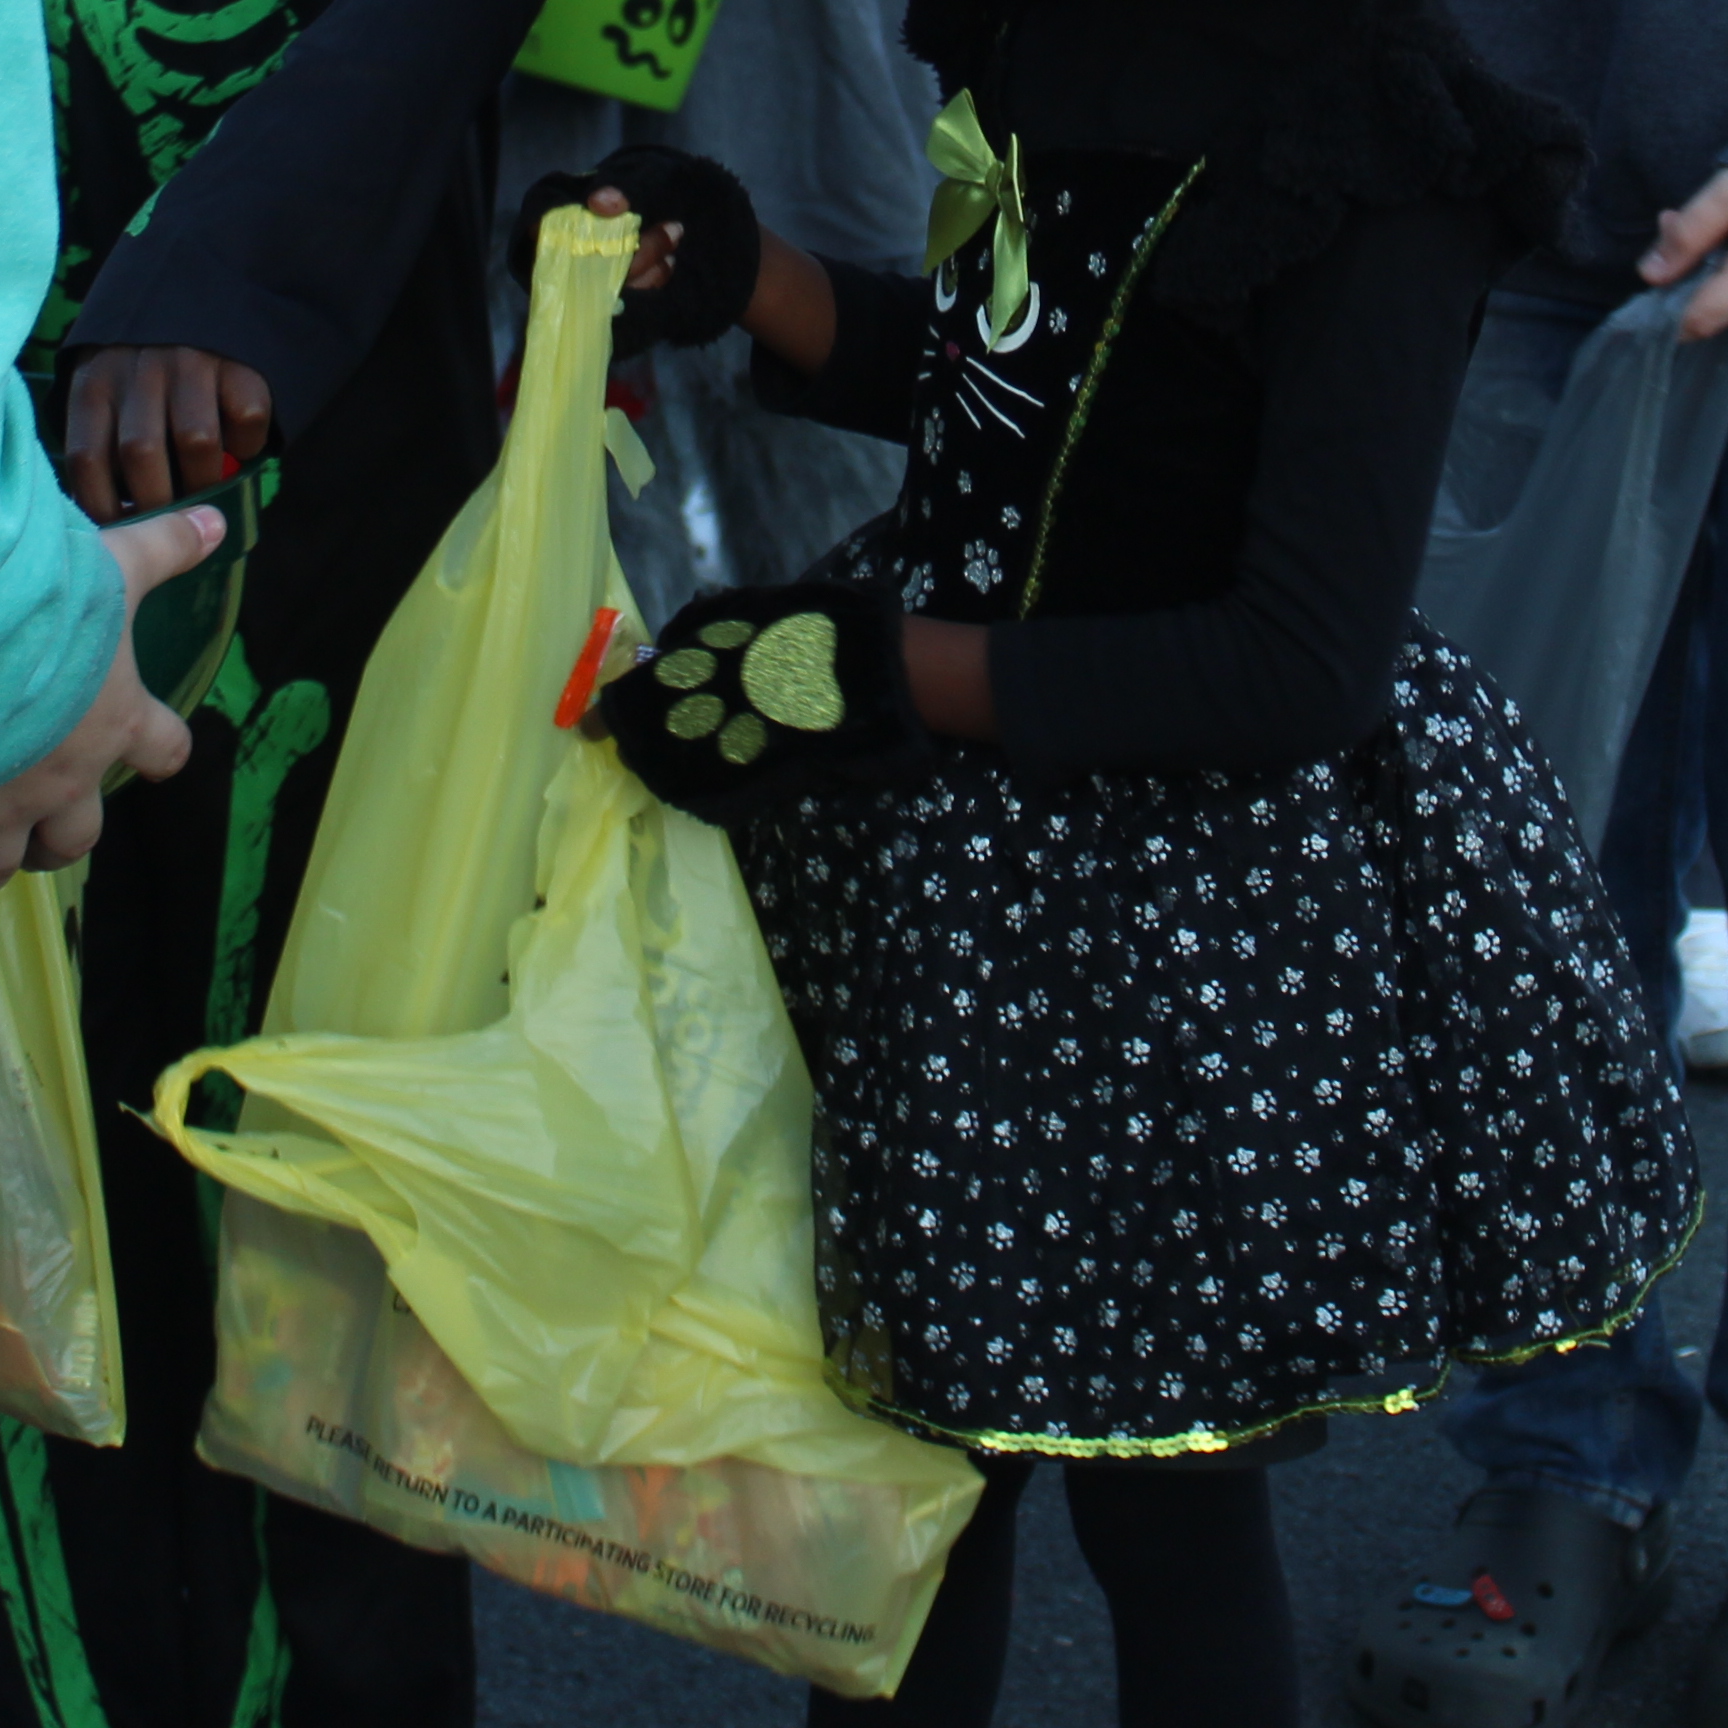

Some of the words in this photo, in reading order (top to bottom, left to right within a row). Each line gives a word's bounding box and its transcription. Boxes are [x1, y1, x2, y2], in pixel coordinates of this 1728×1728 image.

[373, 1454, 449, 1507] RETURN
[453, 1489, 481, 1516] TO
[482, 1501, 498, 1523] A
[653, 1559, 715, 1601] STORE
[720, 1584, 763, 1621] FOR
[764, 1600, 876, 1645] RECYCLING
